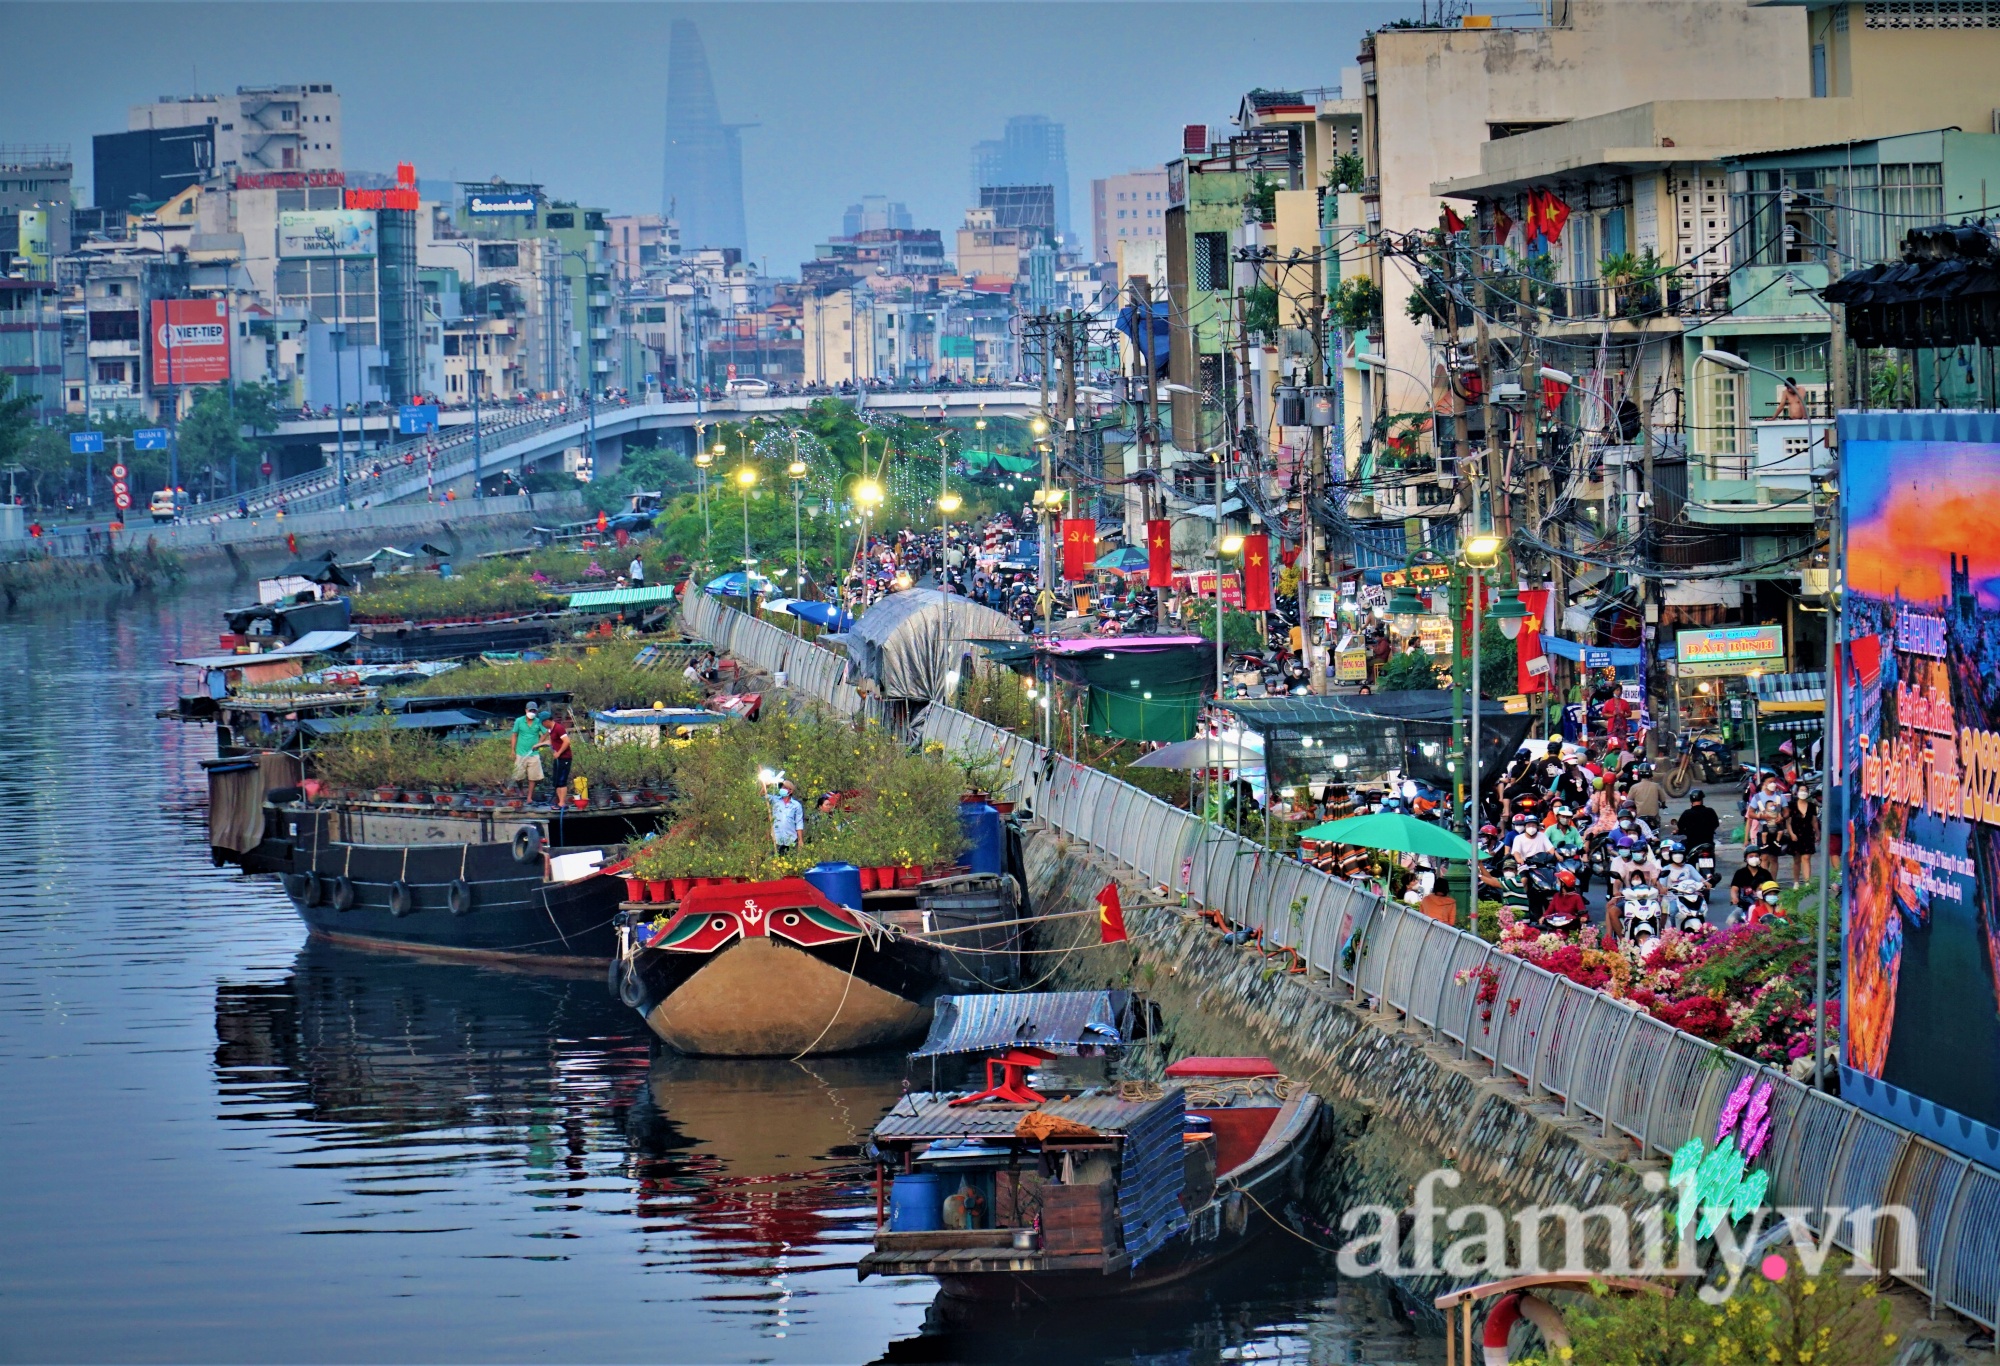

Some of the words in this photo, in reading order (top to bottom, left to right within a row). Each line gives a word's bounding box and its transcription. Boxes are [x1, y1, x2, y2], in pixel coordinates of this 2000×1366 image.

[472, 199, 534, 212] Sacombank
[304, 242, 346, 250] IMPLANT
[75, 433, 93, 442] QUẬN
[1222, 577, 1237, 589] 50%
[1726, 629, 1759, 640] QUAY
[1929, 686, 1952, 735] Xuân
[1860, 734, 1881, 799] Trên
[1882, 737, 1901, 802] Bến
[1924, 748, 1960, 823] Thuyền
[1961, 726, 2000, 826] 2022
